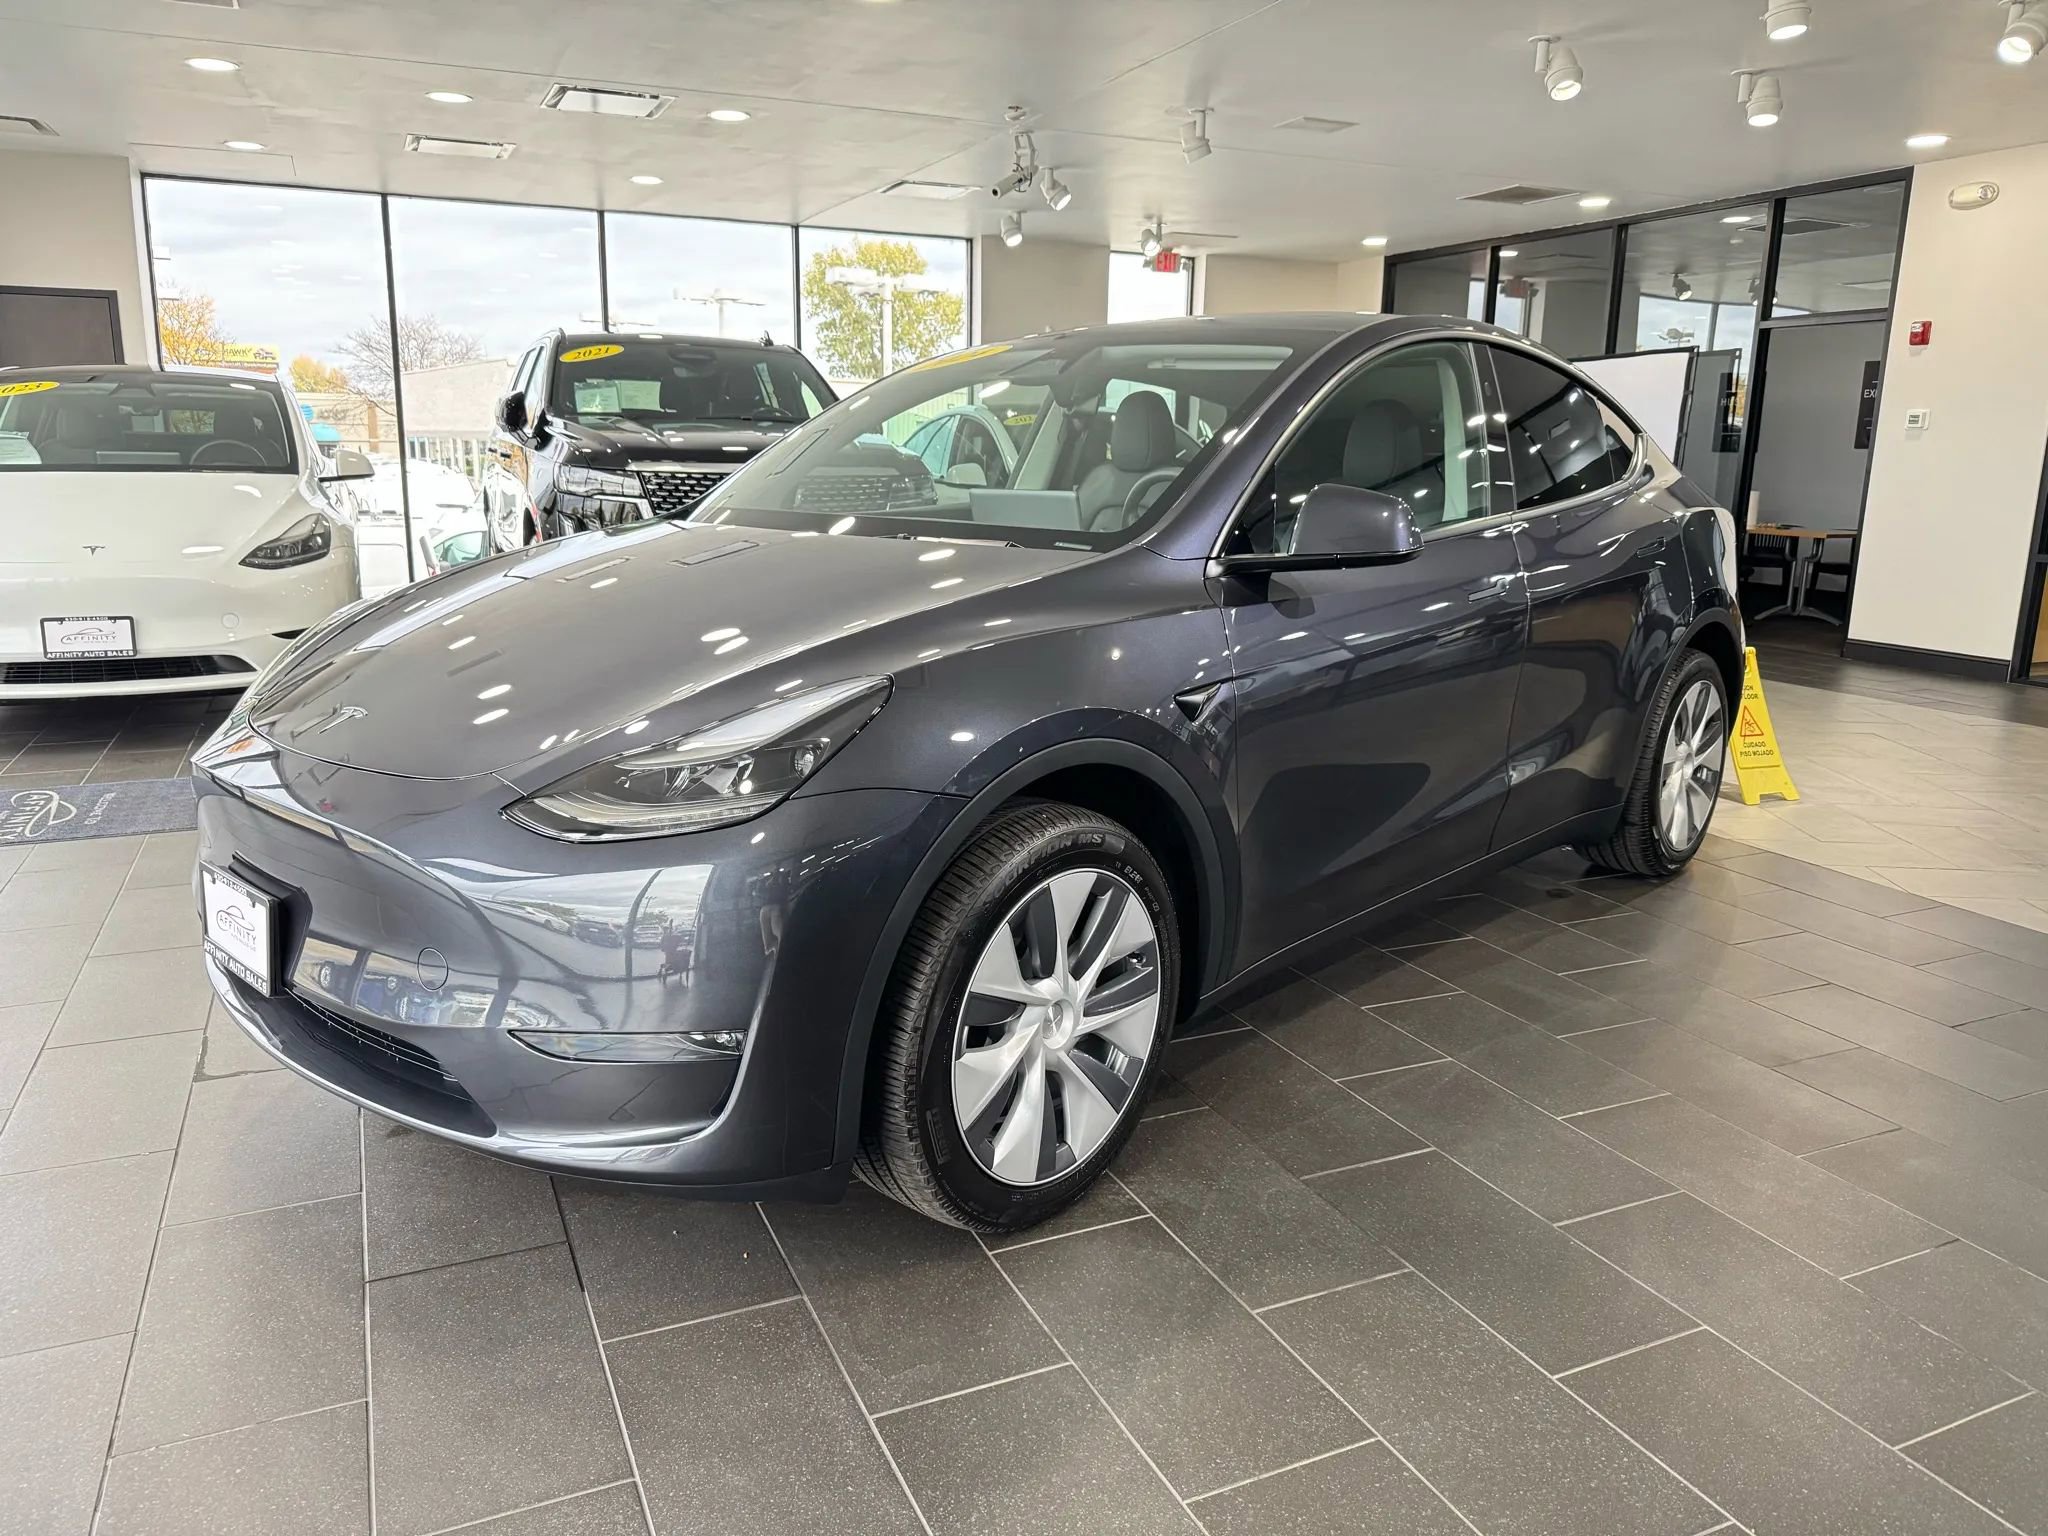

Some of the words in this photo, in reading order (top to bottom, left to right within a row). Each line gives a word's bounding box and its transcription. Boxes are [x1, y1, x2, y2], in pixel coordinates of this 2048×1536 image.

[573, 346, 611, 360] 2021
[107, 649, 134, 657] SALES
[0, 794, 50, 840] AFFINITY
[219, 914, 256, 945] AFFINITY
[204, 940, 229, 966] AFFINITY
[229, 961, 245, 979] AUTO
[245, 969, 267, 994] SALES
